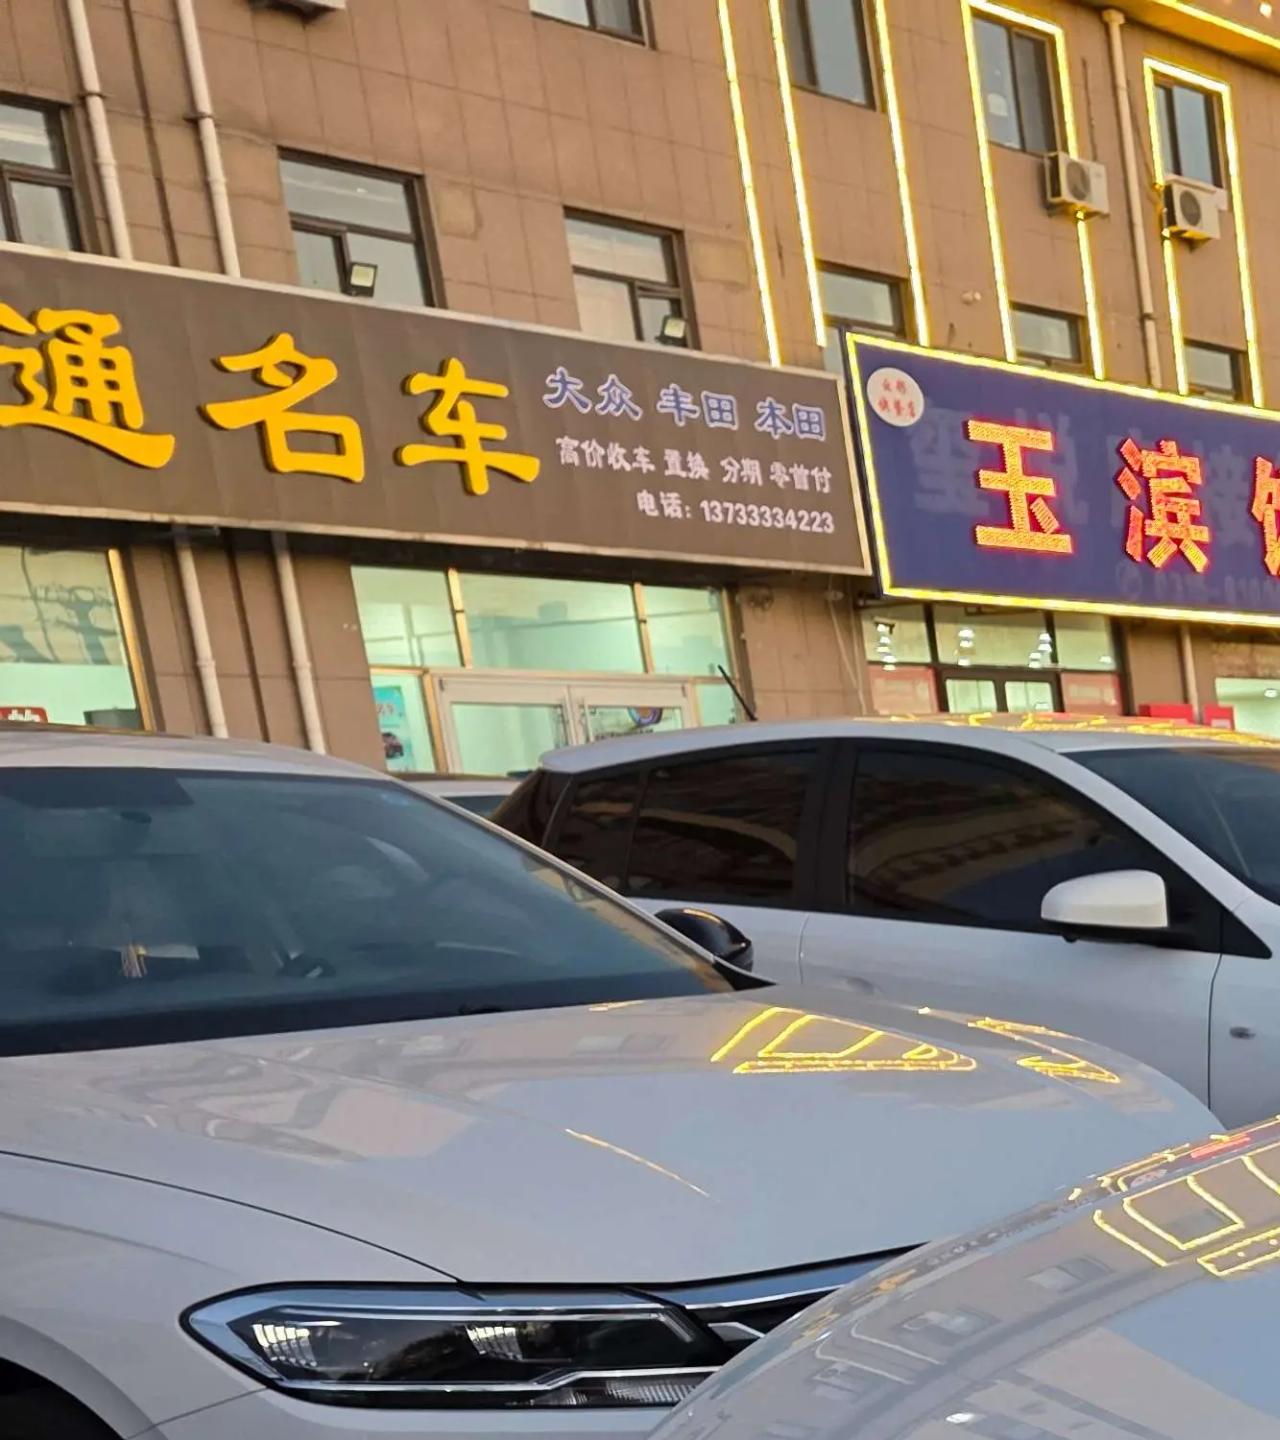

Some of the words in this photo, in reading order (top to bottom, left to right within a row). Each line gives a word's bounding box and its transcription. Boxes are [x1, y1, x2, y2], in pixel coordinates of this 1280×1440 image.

[0, 303, 541, 496] 通名车
[542, 366, 643, 421] 大众
[657, 383, 739, 432] 丰田
[754, 396, 826, 442] 本田
[556, 435, 655, 474] 高价收车
[663, 448, 711, 481] 置换
[720, 456, 763, 487] 分期
[769, 461, 832, 494] 零首付
[700, 500, 835, 534] 13733334223
